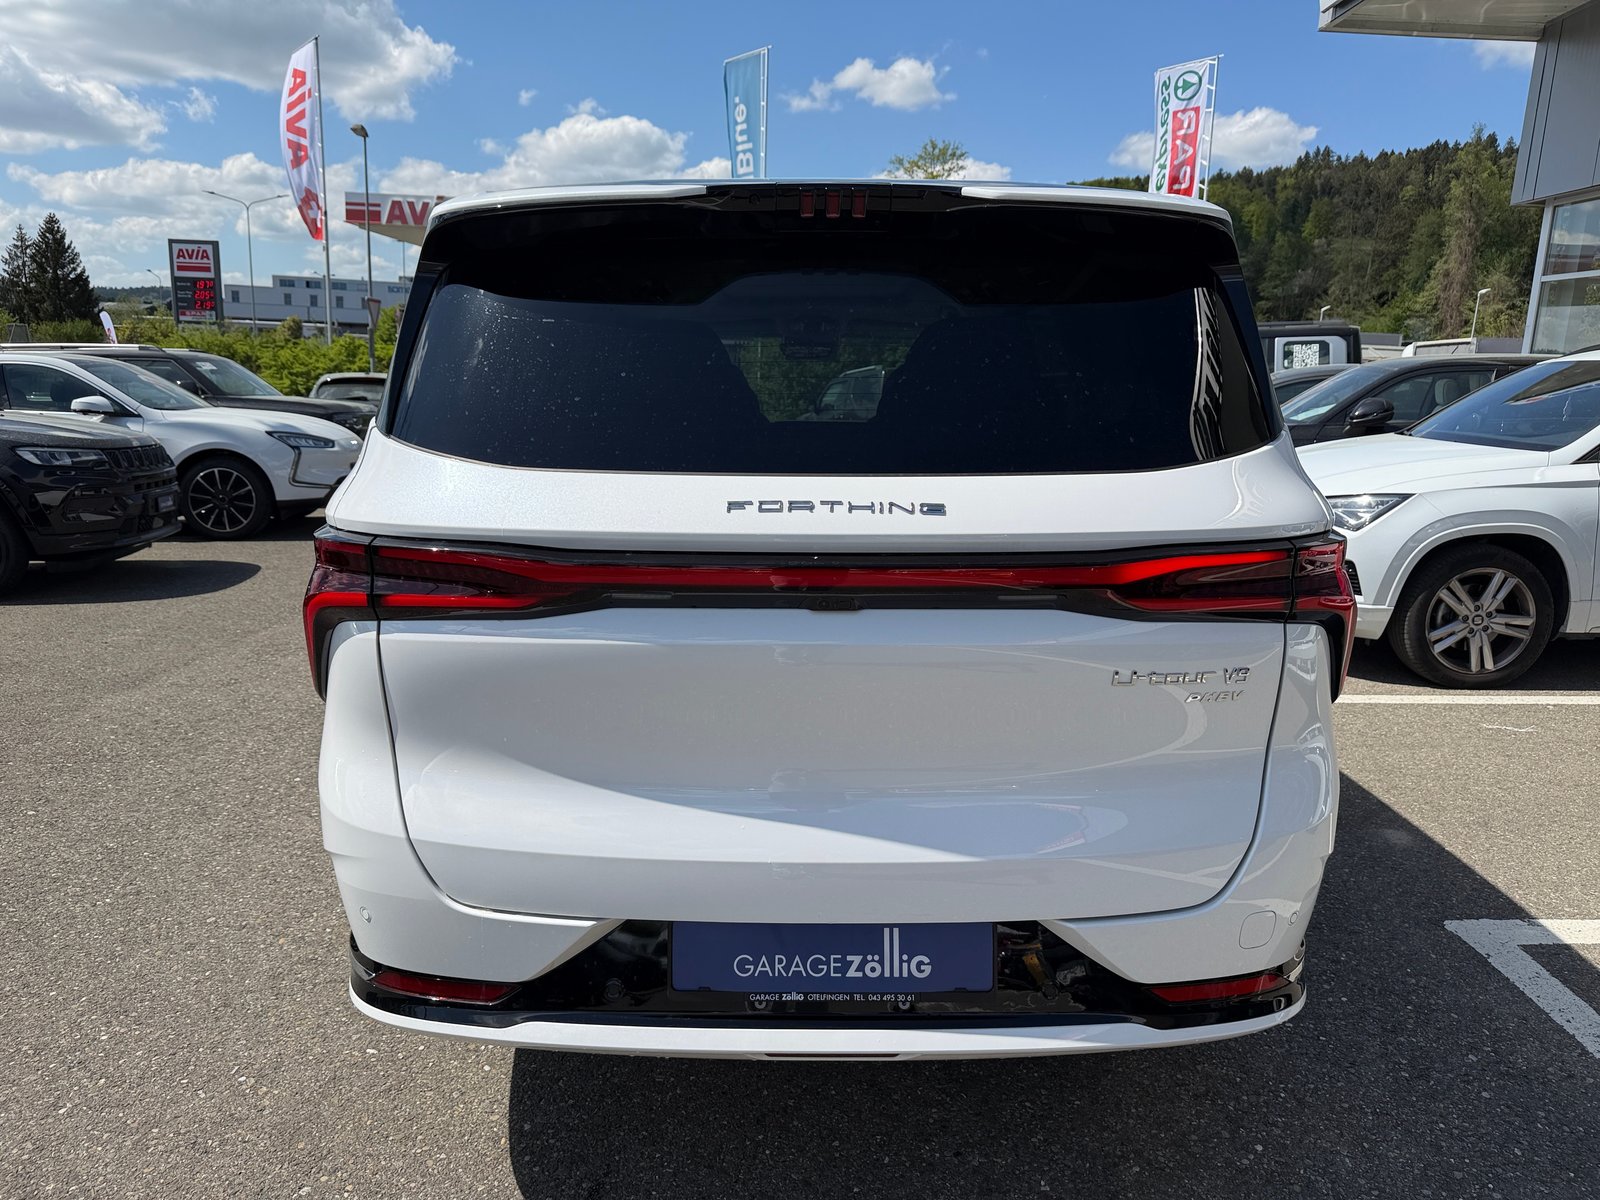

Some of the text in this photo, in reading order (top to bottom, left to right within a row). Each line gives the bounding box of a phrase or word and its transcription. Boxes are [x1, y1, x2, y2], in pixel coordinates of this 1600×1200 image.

[176, 246, 210, 260] AVIA
[726, 500, 947, 516] FORTHING
[733, 955, 842, 978] GARAGE
[749, 993, 780, 1001] GARAGE
[807, 993, 850, 1001] OTELFINGEN
[868, 993, 881, 1001] 043
[883, 993, 895, 1001] 495
[896, 993, 906, 1001] 30
[907, 993, 915, 1001] 61
